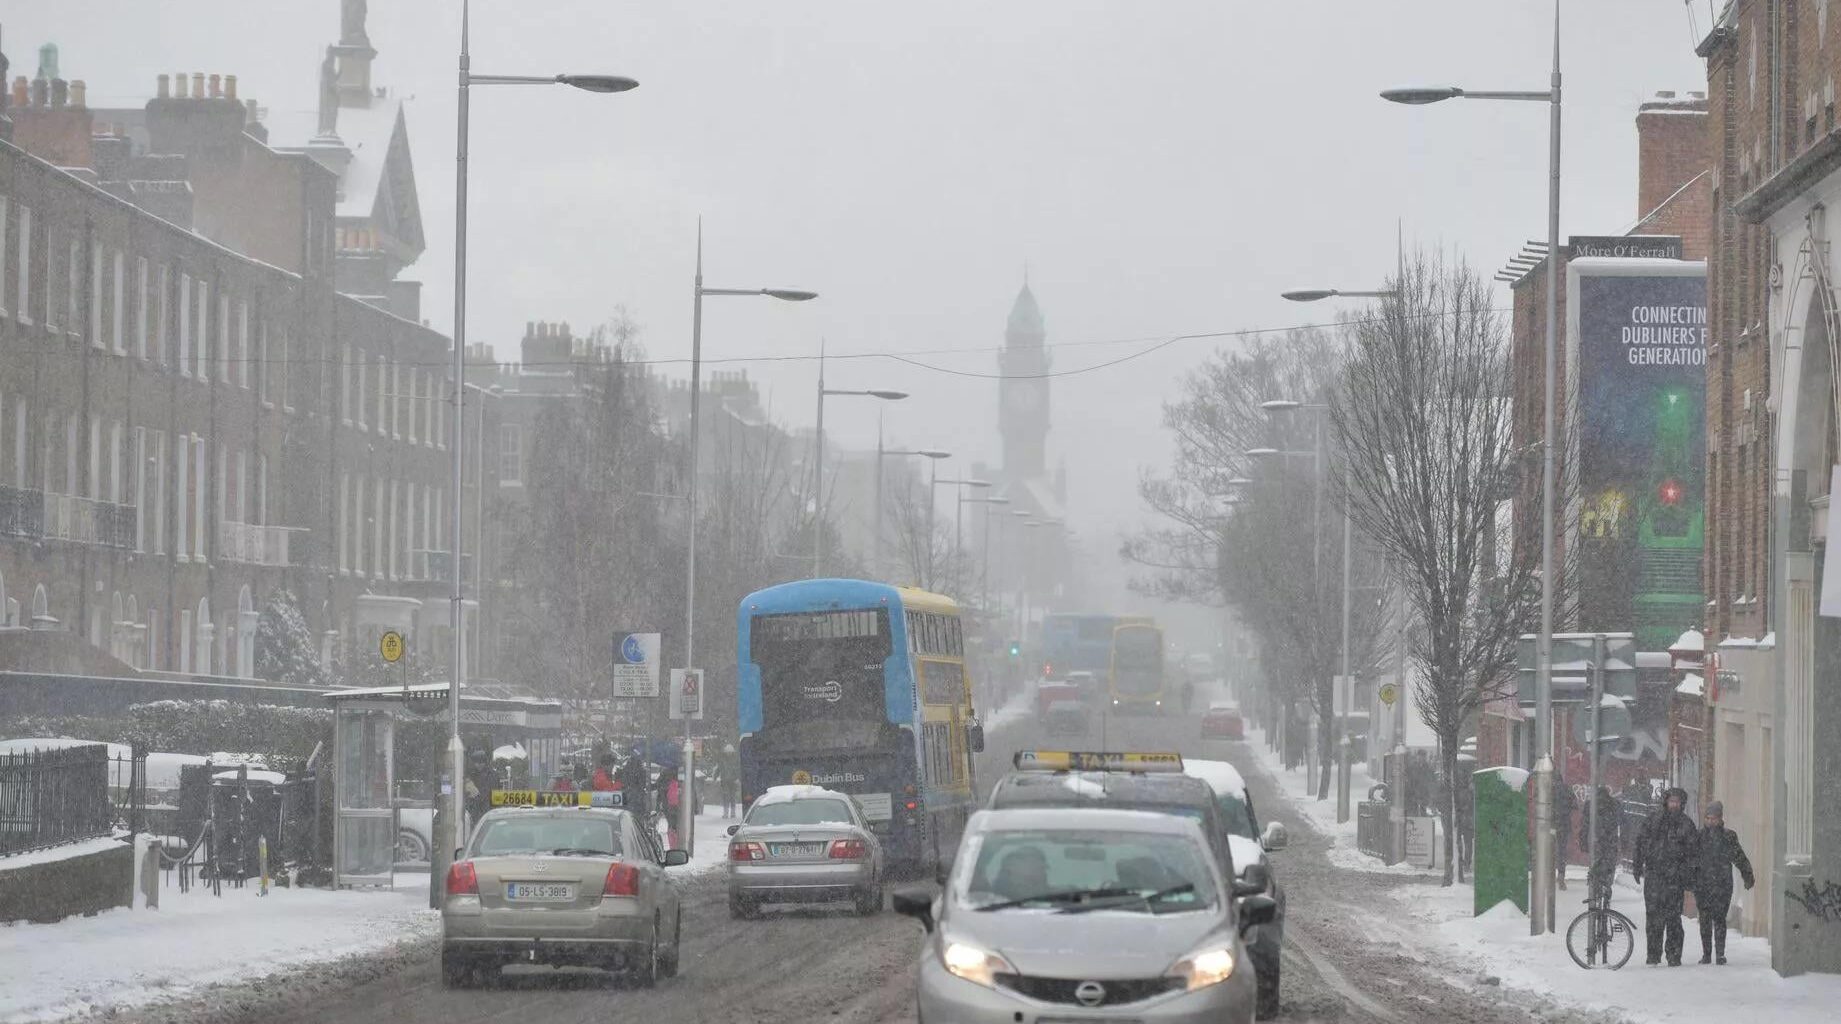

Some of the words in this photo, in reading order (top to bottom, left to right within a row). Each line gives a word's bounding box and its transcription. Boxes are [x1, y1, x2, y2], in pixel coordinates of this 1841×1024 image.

[1576, 244, 1611, 258] More
[1622, 327, 1696, 345] DUBLINERS
[1079, 754, 1124, 767] TAXI
[812, 774, 843, 784] Dublin
[845, 772, 865, 782] Bus
[503, 790, 532, 805] 26684
[542, 793, 573, 806] TAXI
[612, 794, 622, 805] D
